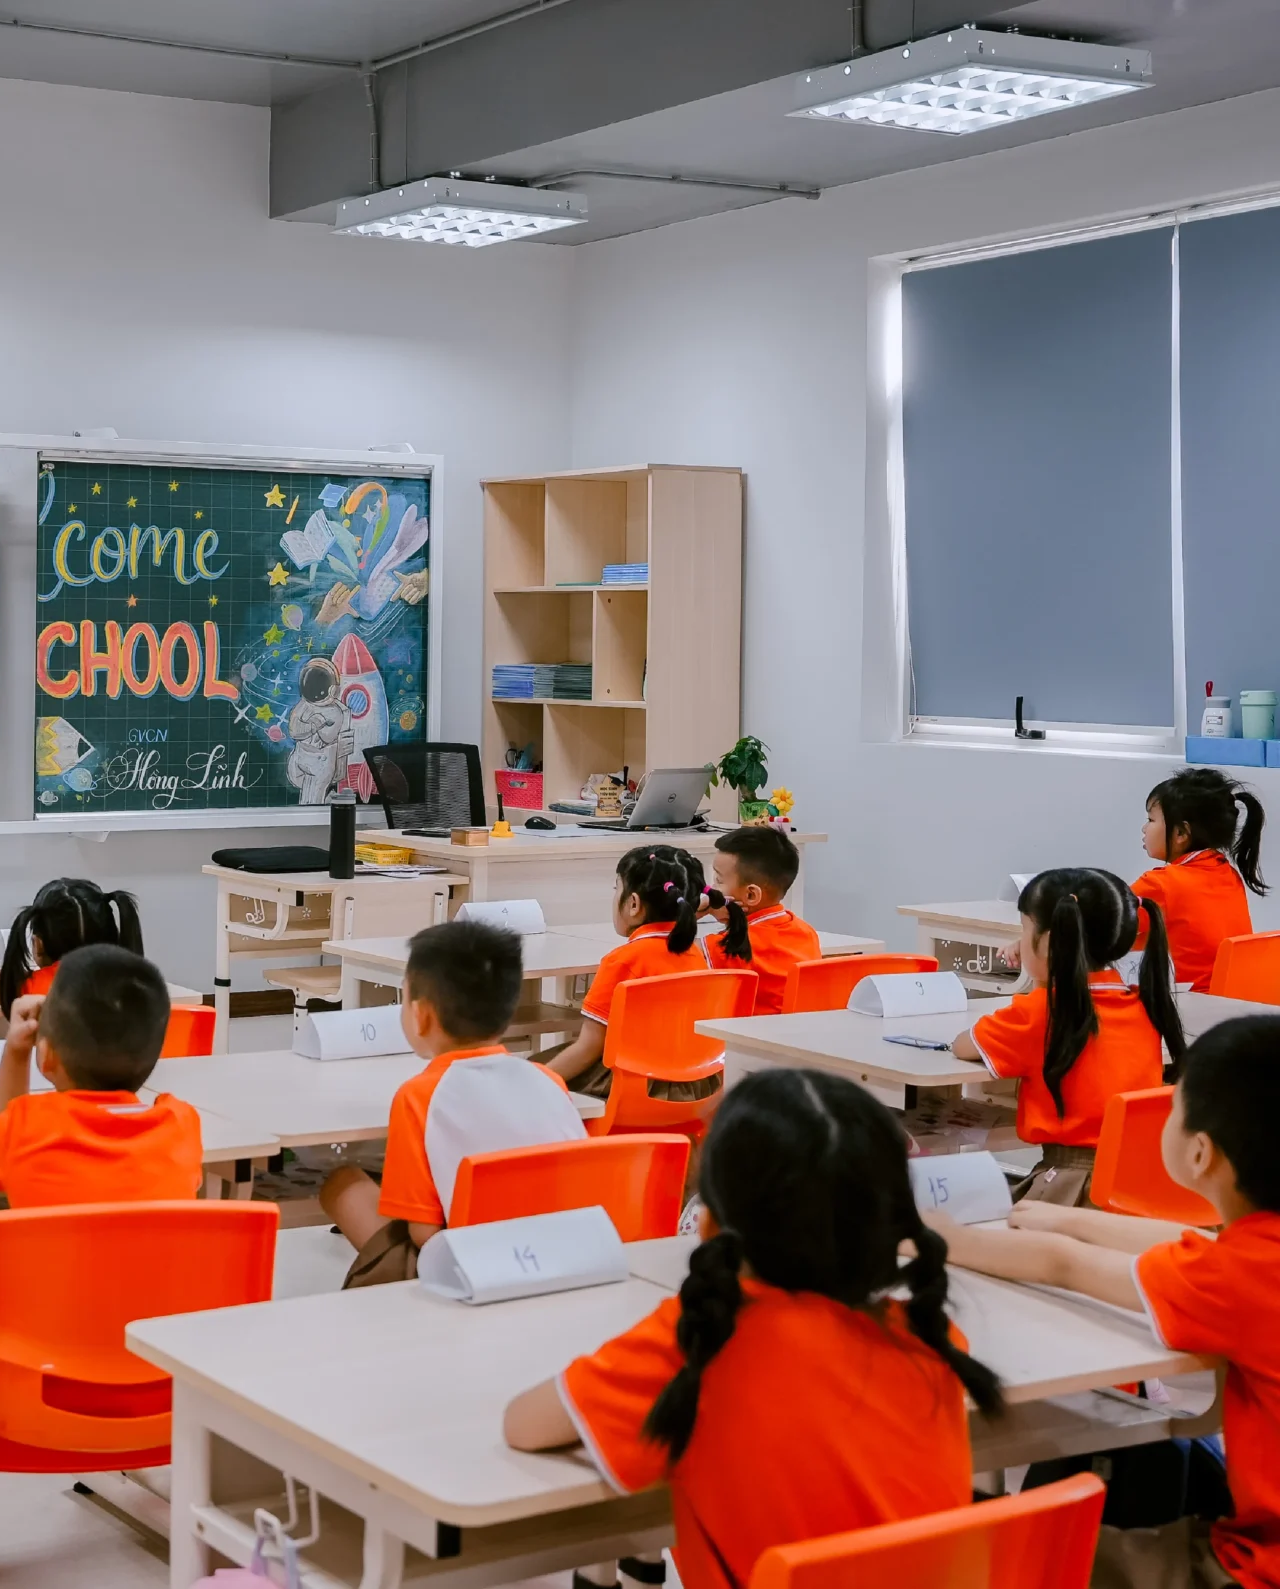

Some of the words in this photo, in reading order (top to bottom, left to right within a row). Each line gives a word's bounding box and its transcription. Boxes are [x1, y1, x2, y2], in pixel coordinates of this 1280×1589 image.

[37, 620, 241, 701] CHOOL
[128, 728, 168, 743] GVCN
[915, 981, 925, 996] 9
[360, 1022, 376, 1042] 10
[927, 1176, 949, 1208] 15
